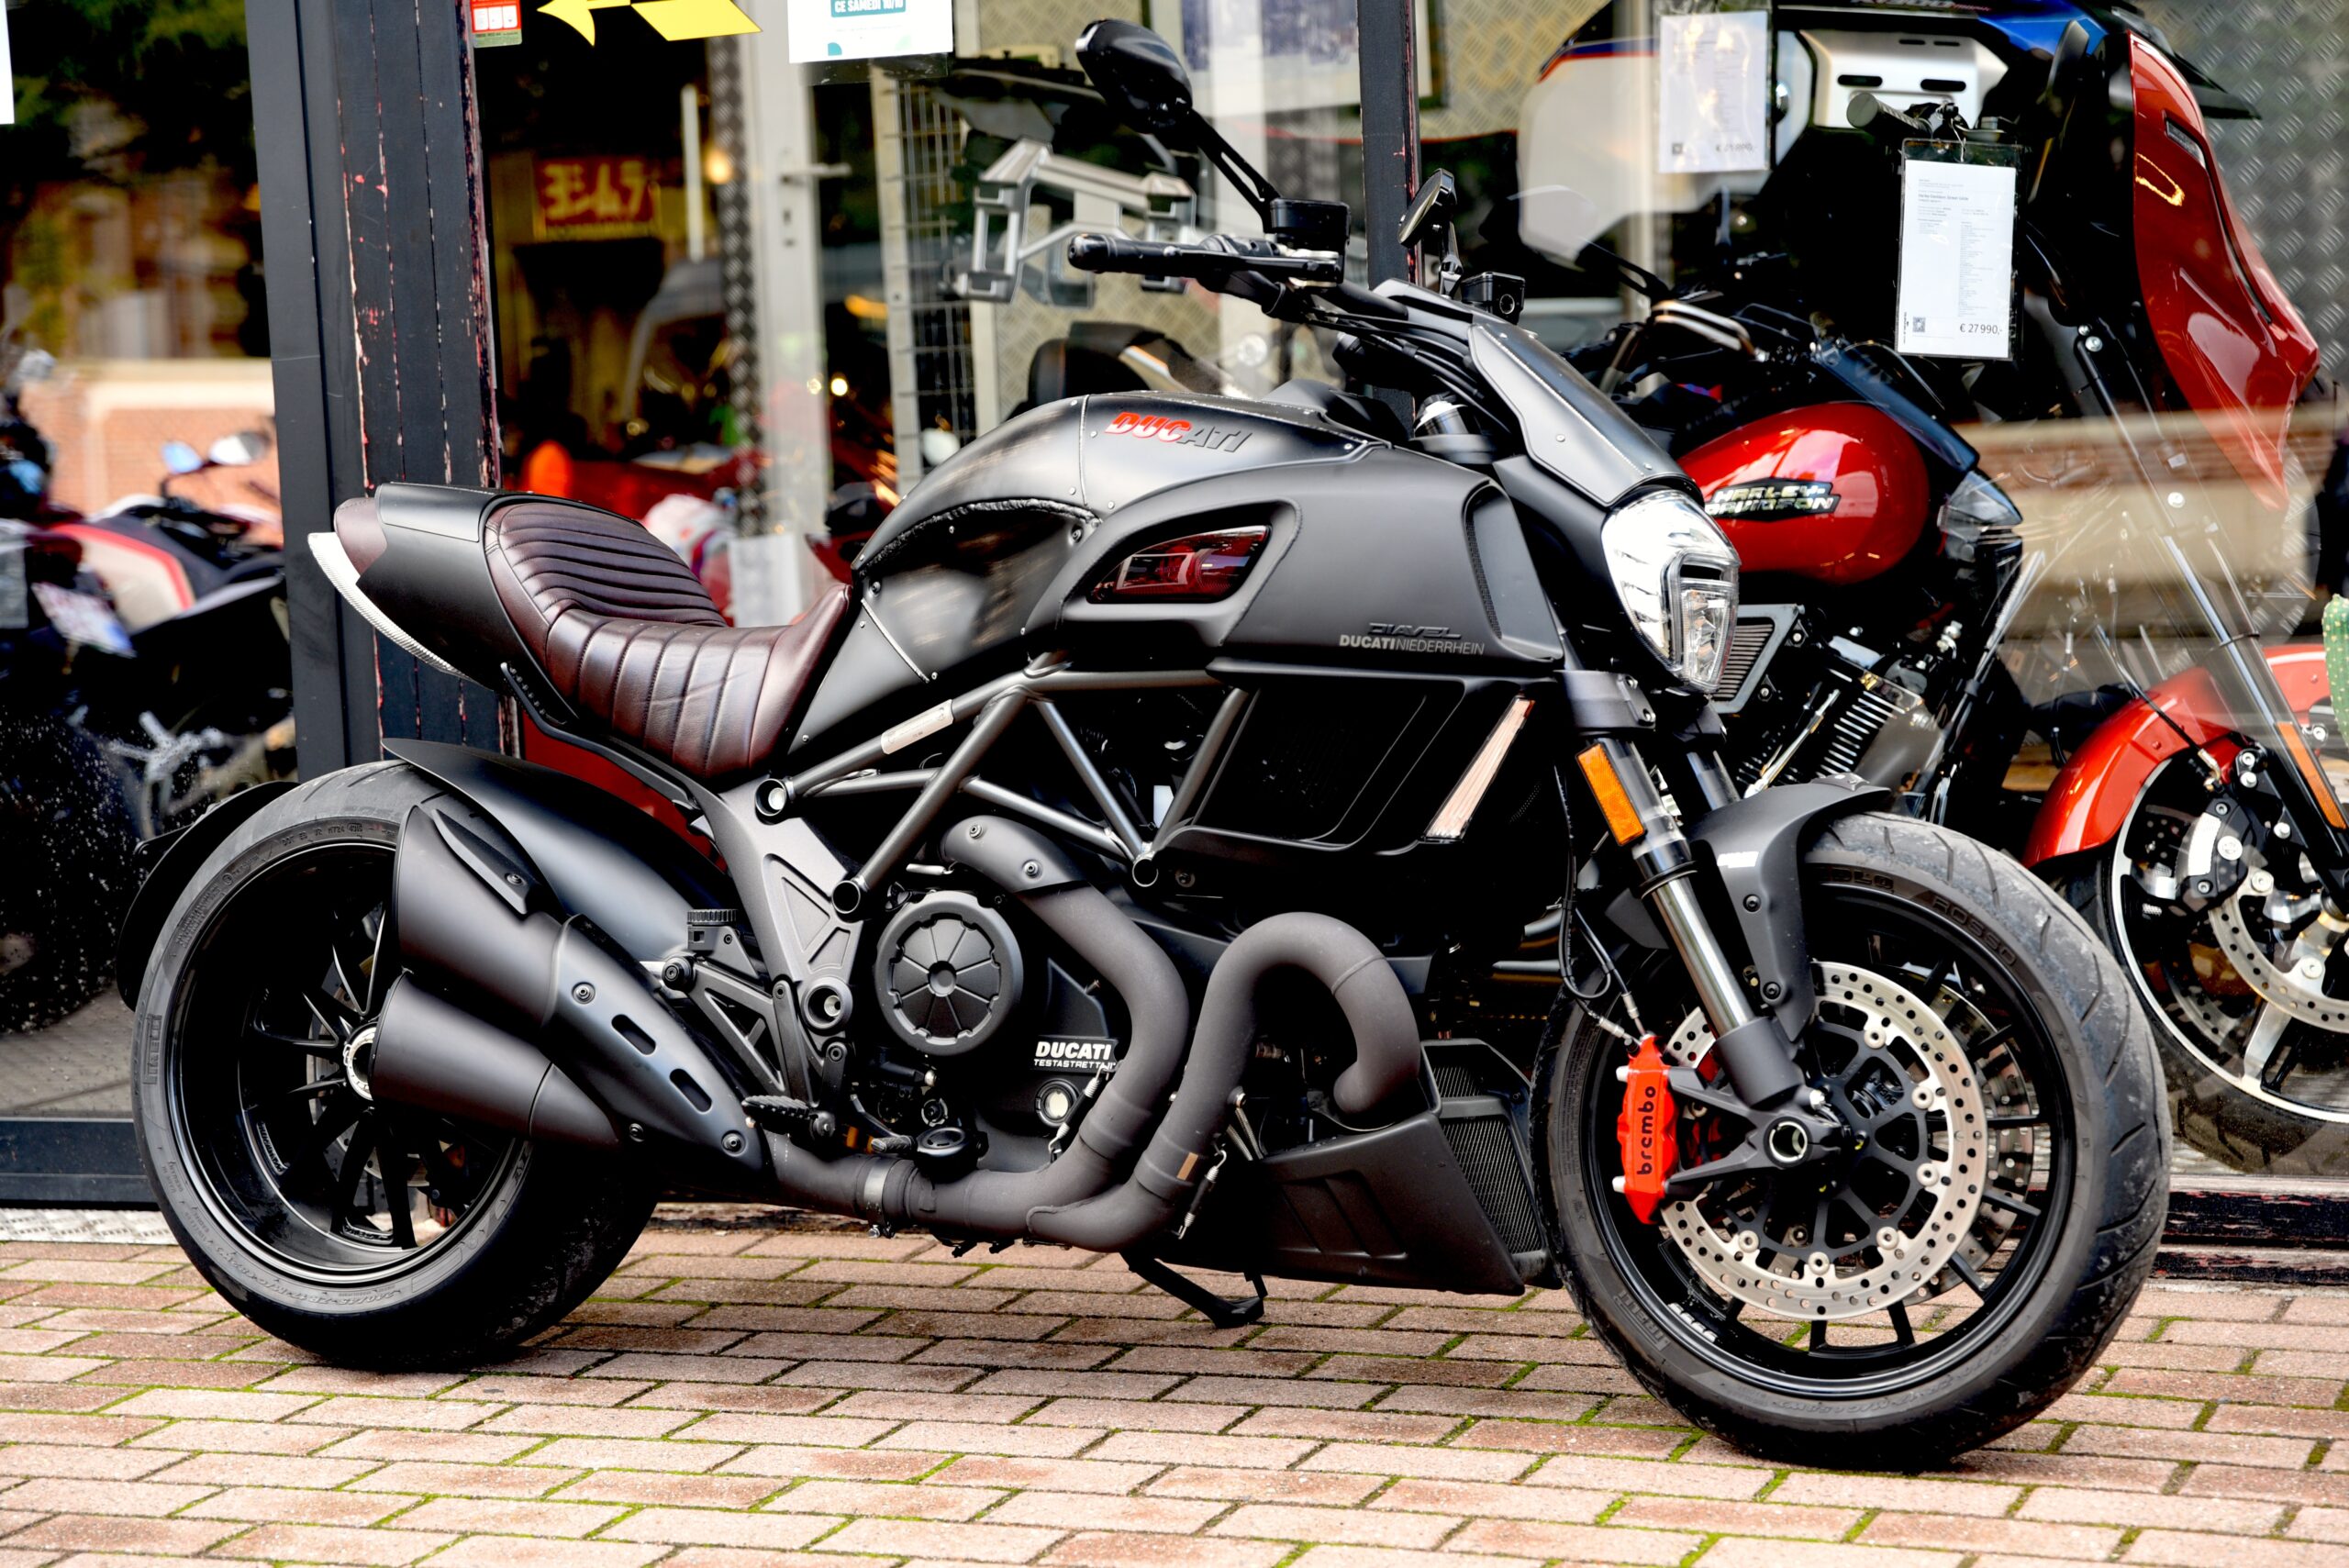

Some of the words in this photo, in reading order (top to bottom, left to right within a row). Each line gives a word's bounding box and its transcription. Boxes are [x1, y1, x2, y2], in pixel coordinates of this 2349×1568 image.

[1960, 323, 1965, 333] €
[1105, 412, 1252, 452] DUCATI
[1368, 622, 1462, 639] DIAVEL
[1932, 895, 2017, 967] ROSSO
[1035, 1041, 1111, 1060] DUCATI
[1636, 1085, 1656, 1175] brembo
